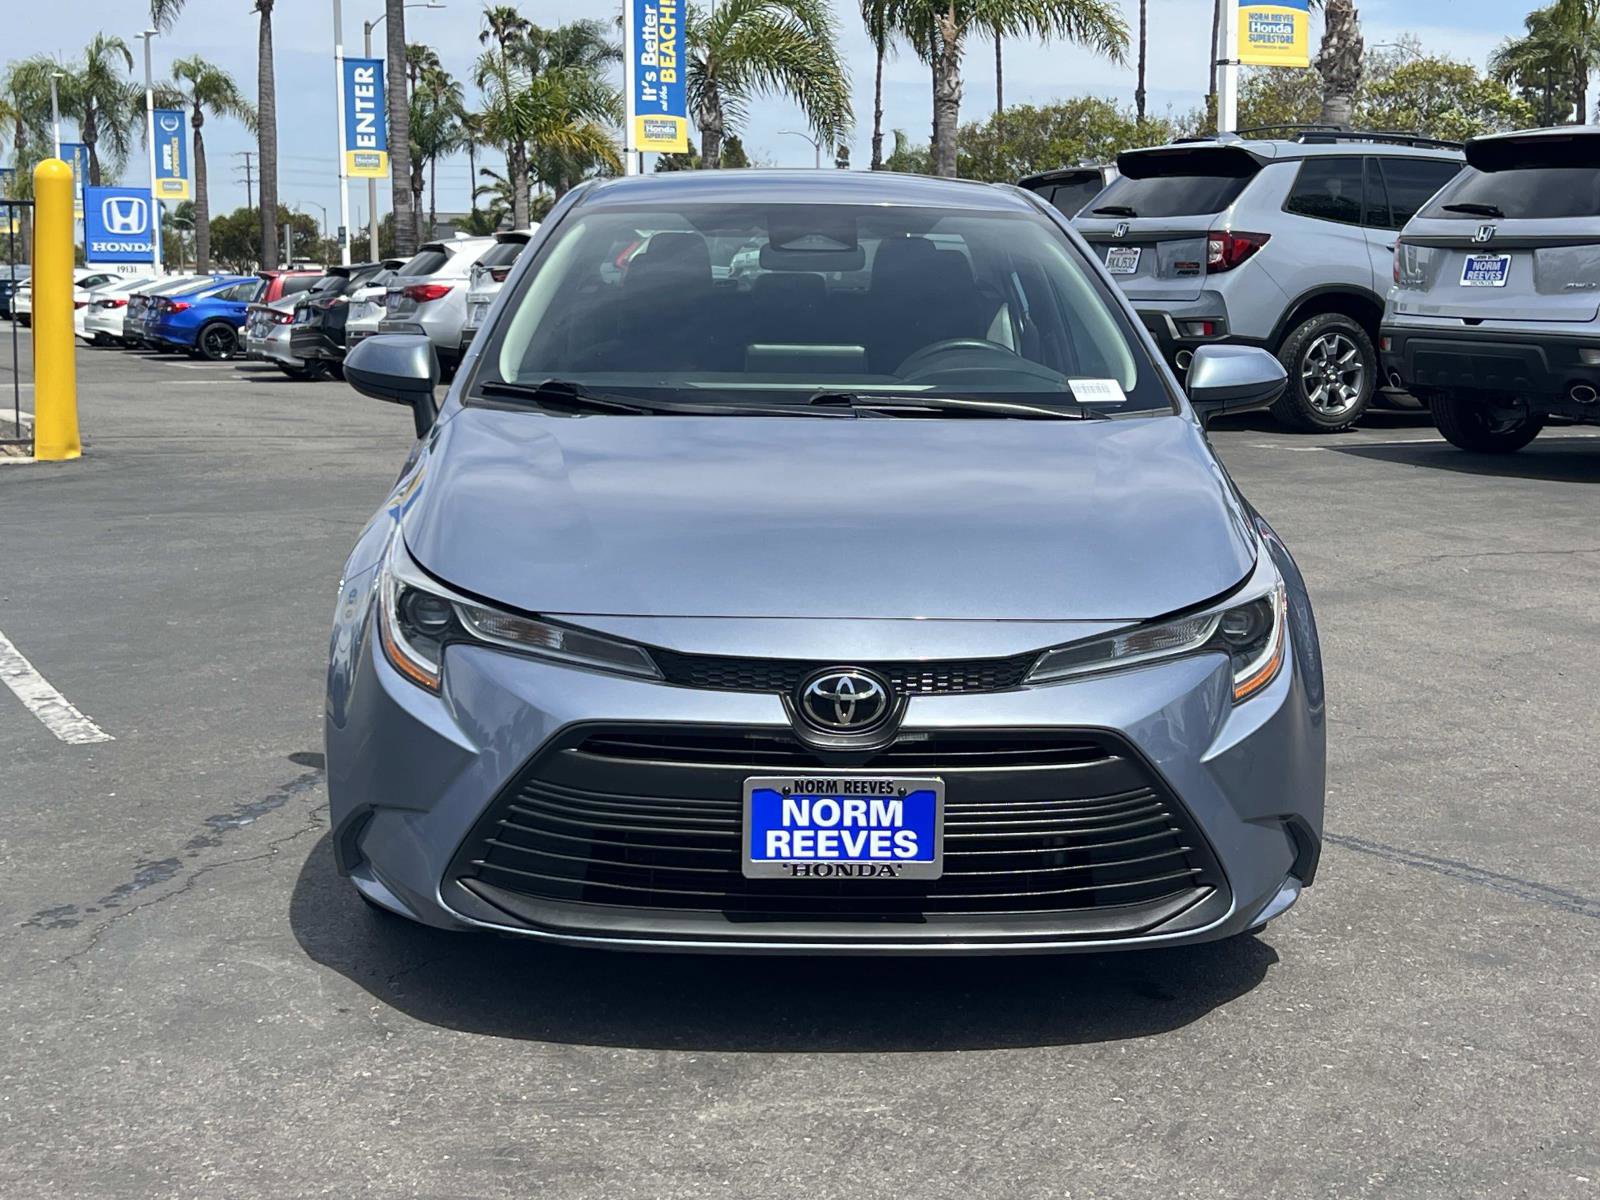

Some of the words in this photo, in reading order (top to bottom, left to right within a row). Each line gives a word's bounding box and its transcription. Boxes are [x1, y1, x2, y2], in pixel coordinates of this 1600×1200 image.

[1251, 22, 1292, 33] Honda
[641, 4, 657, 66] Better
[1248, 34, 1294, 44] SUPERSTORE
[642, 71, 657, 101] It's
[354, 66, 376, 147] ENTER
[646, 125, 676, 134] Honda
[92, 242, 155, 252] HONDA
[1472, 261, 1501, 270] NORM
[1467, 271, 1502, 280] REEVES
[794, 780, 838, 794] NORM
[844, 781, 894, 795] REEVES
[782, 799, 903, 827] NORM
[766, 830, 919, 858] REEVES
[790, 864, 899, 877] HONDA
